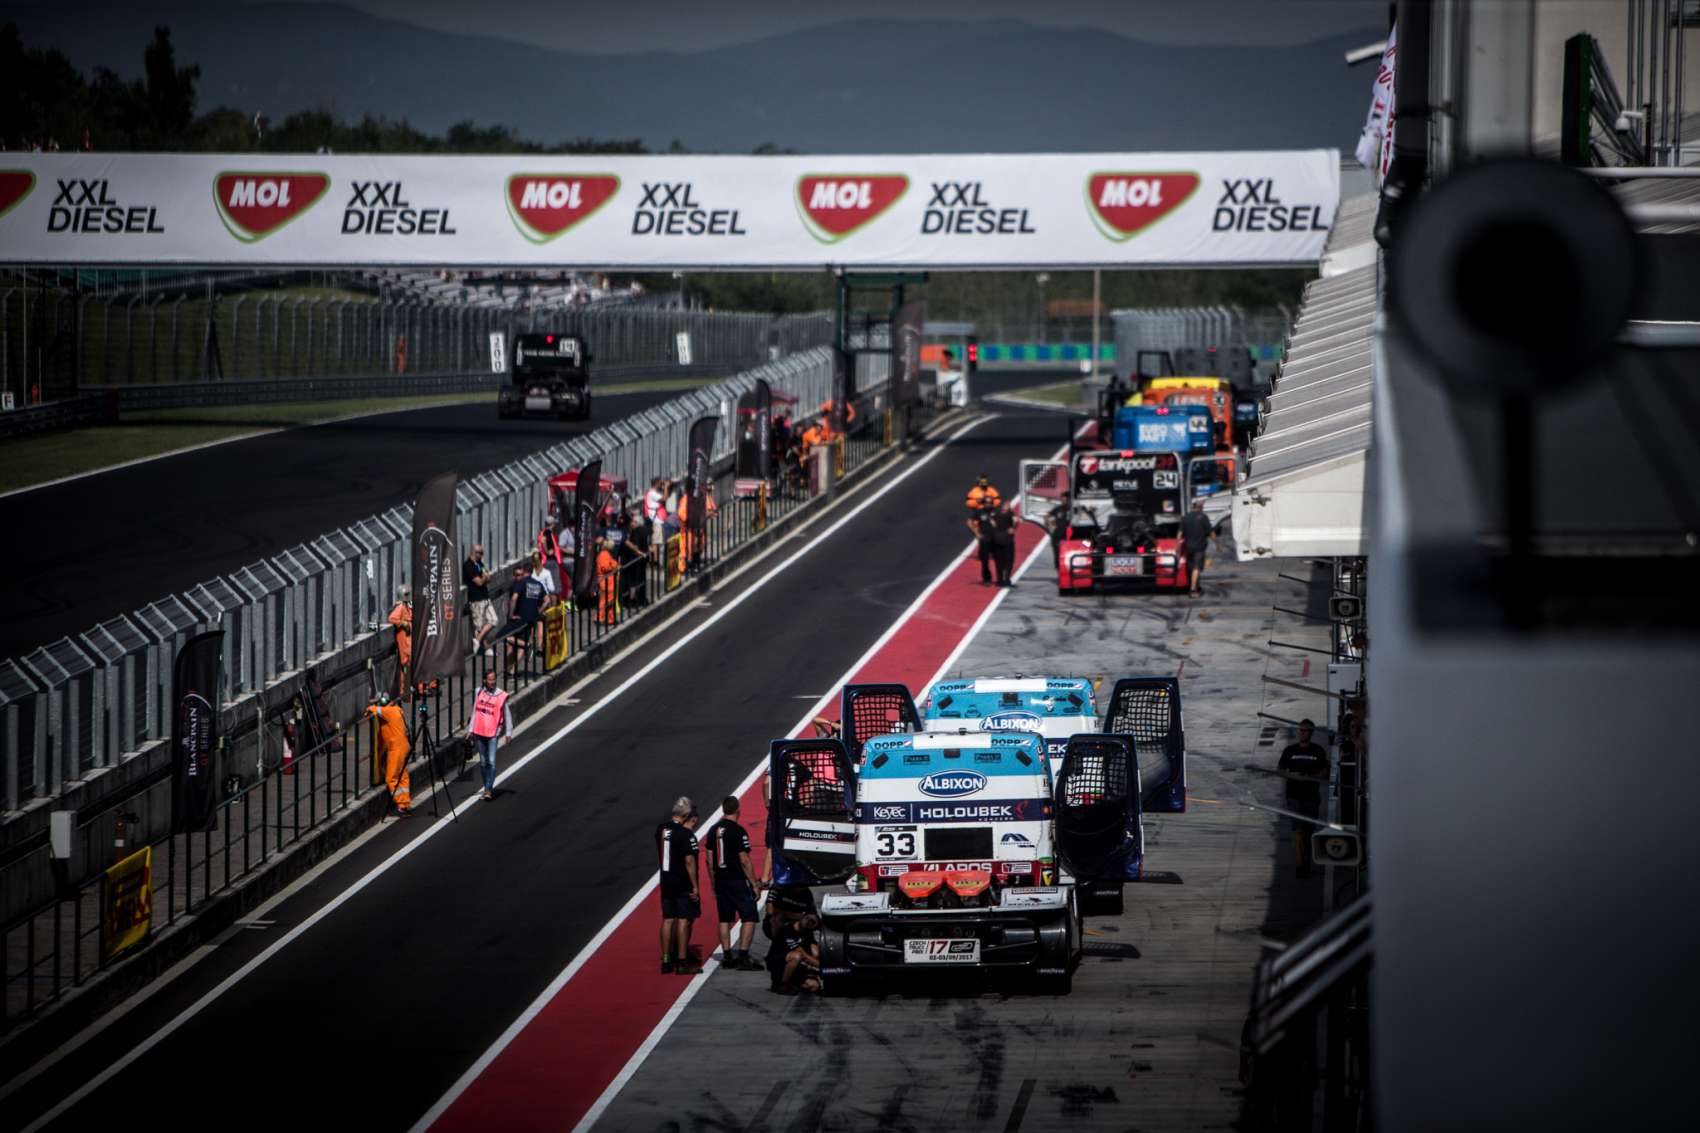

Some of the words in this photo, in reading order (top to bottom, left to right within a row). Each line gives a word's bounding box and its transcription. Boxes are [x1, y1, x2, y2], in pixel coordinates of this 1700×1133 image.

[54, 179, 117, 205] XXL
[229, 180, 291, 208] MOL
[347, 181, 409, 207] XXL
[520, 181, 582, 209] MOL
[640, 183, 699, 207] XXL
[809, 181, 872, 209] MOL
[930, 183, 988, 207] XXL
[1099, 179, 1163, 207] MOL
[1220, 179, 1280, 204] XXL
[47, 206, 165, 233] DIESEL
[342, 208, 457, 234] DIESEL
[633, 210, 746, 235] DIESEL
[923, 209, 1035, 234] DIESEL
[1213, 204, 1329, 232] DIESEL
[1155, 472, 1177, 488] 24
[442, 558, 453, 601] SERIES
[982, 716, 1040, 731] ALBIXON
[187, 707, 197, 776] BLANCPAIN
[874, 740, 904, 750] DOPP
[991, 738, 1021, 747] DOPP
[922, 776, 984, 790] ALBIXON
[920, 805, 1012, 819] HOLOUBEK
[799, 831, 838, 840] HOLOUBEK
[877, 833, 916, 857] 33
[929, 940, 949, 954] 17
